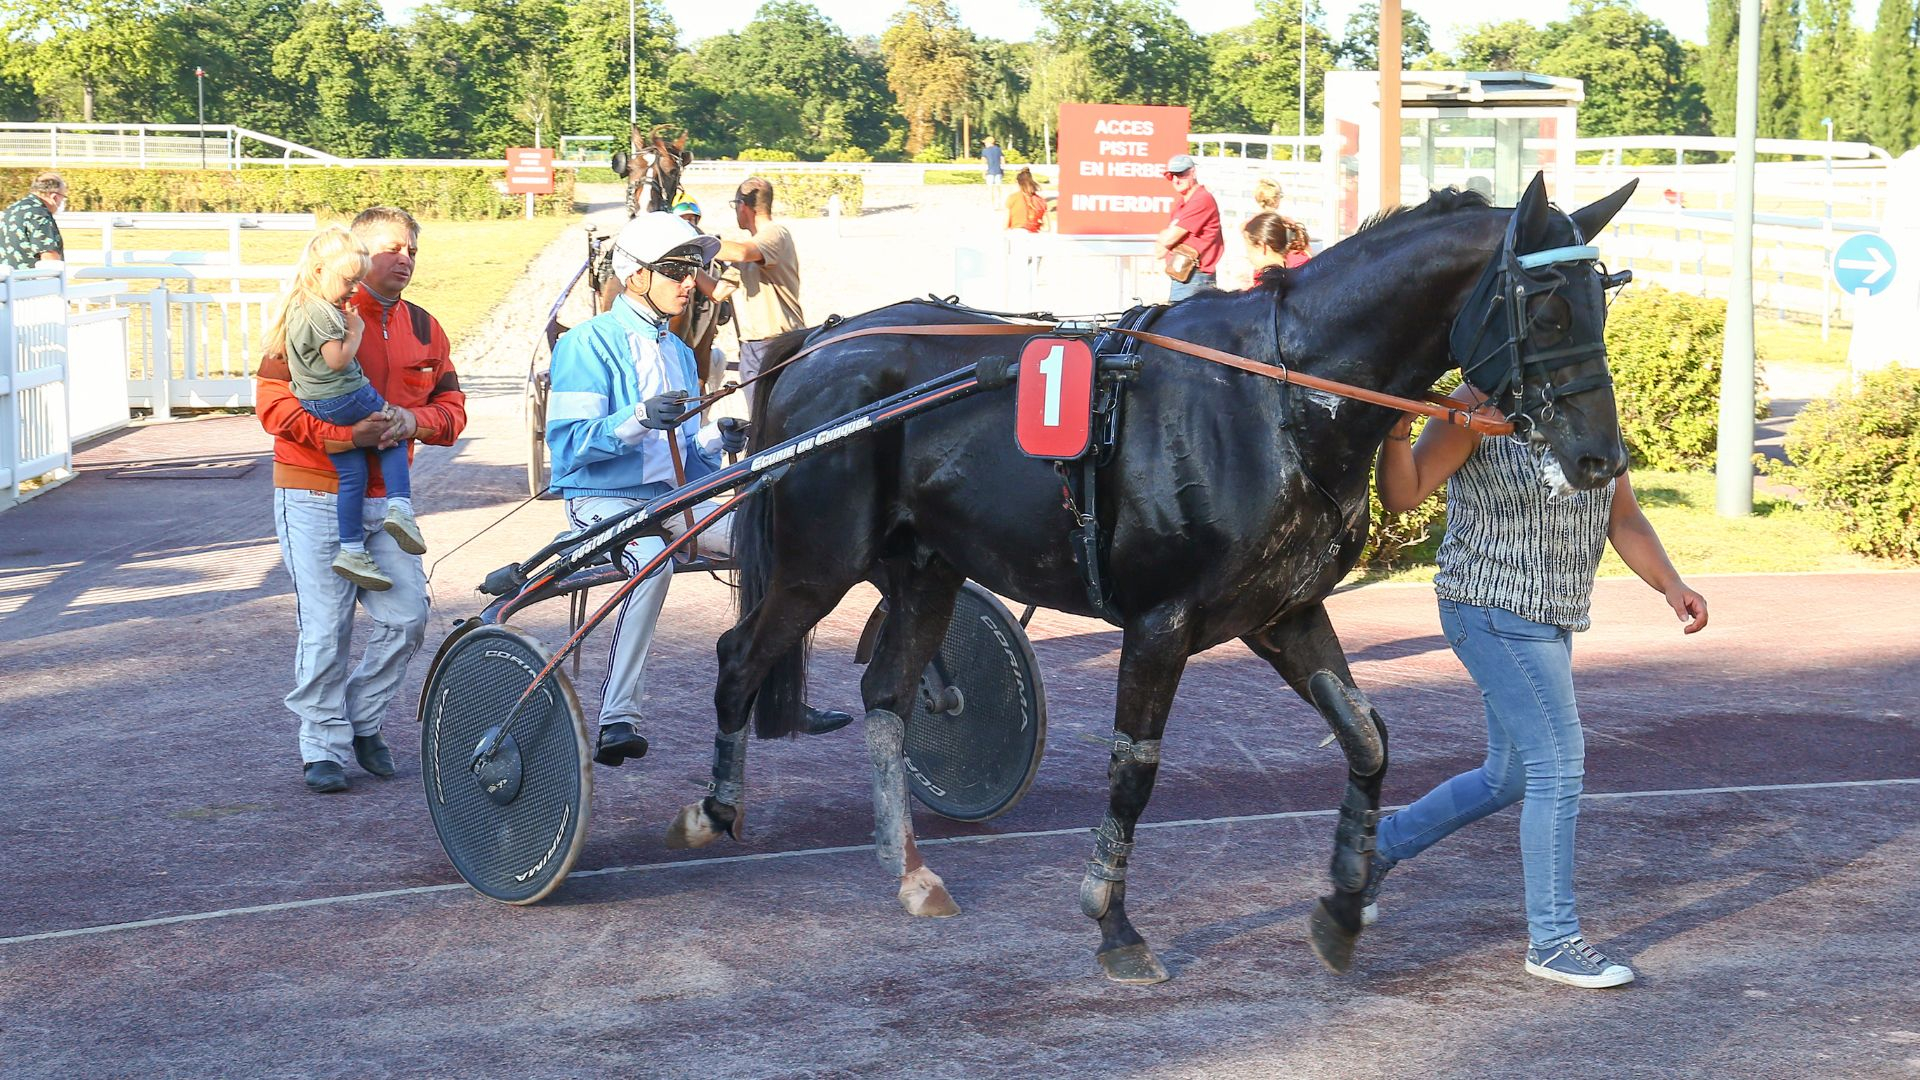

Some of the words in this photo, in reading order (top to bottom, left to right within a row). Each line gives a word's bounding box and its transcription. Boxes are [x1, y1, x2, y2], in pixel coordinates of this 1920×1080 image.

[1094, 119, 1154, 135] ACCES
[1099, 140, 1149, 156] PISTE
[1079, 161, 1104, 176] EN
[1107, 162, 1167, 178] HERBE
[1071, 194, 1174, 213] INTERDIT
[1040, 345, 1065, 426] 1
[980, 615, 1029, 732] CORIMA
[514, 803, 570, 882] CORIMA
